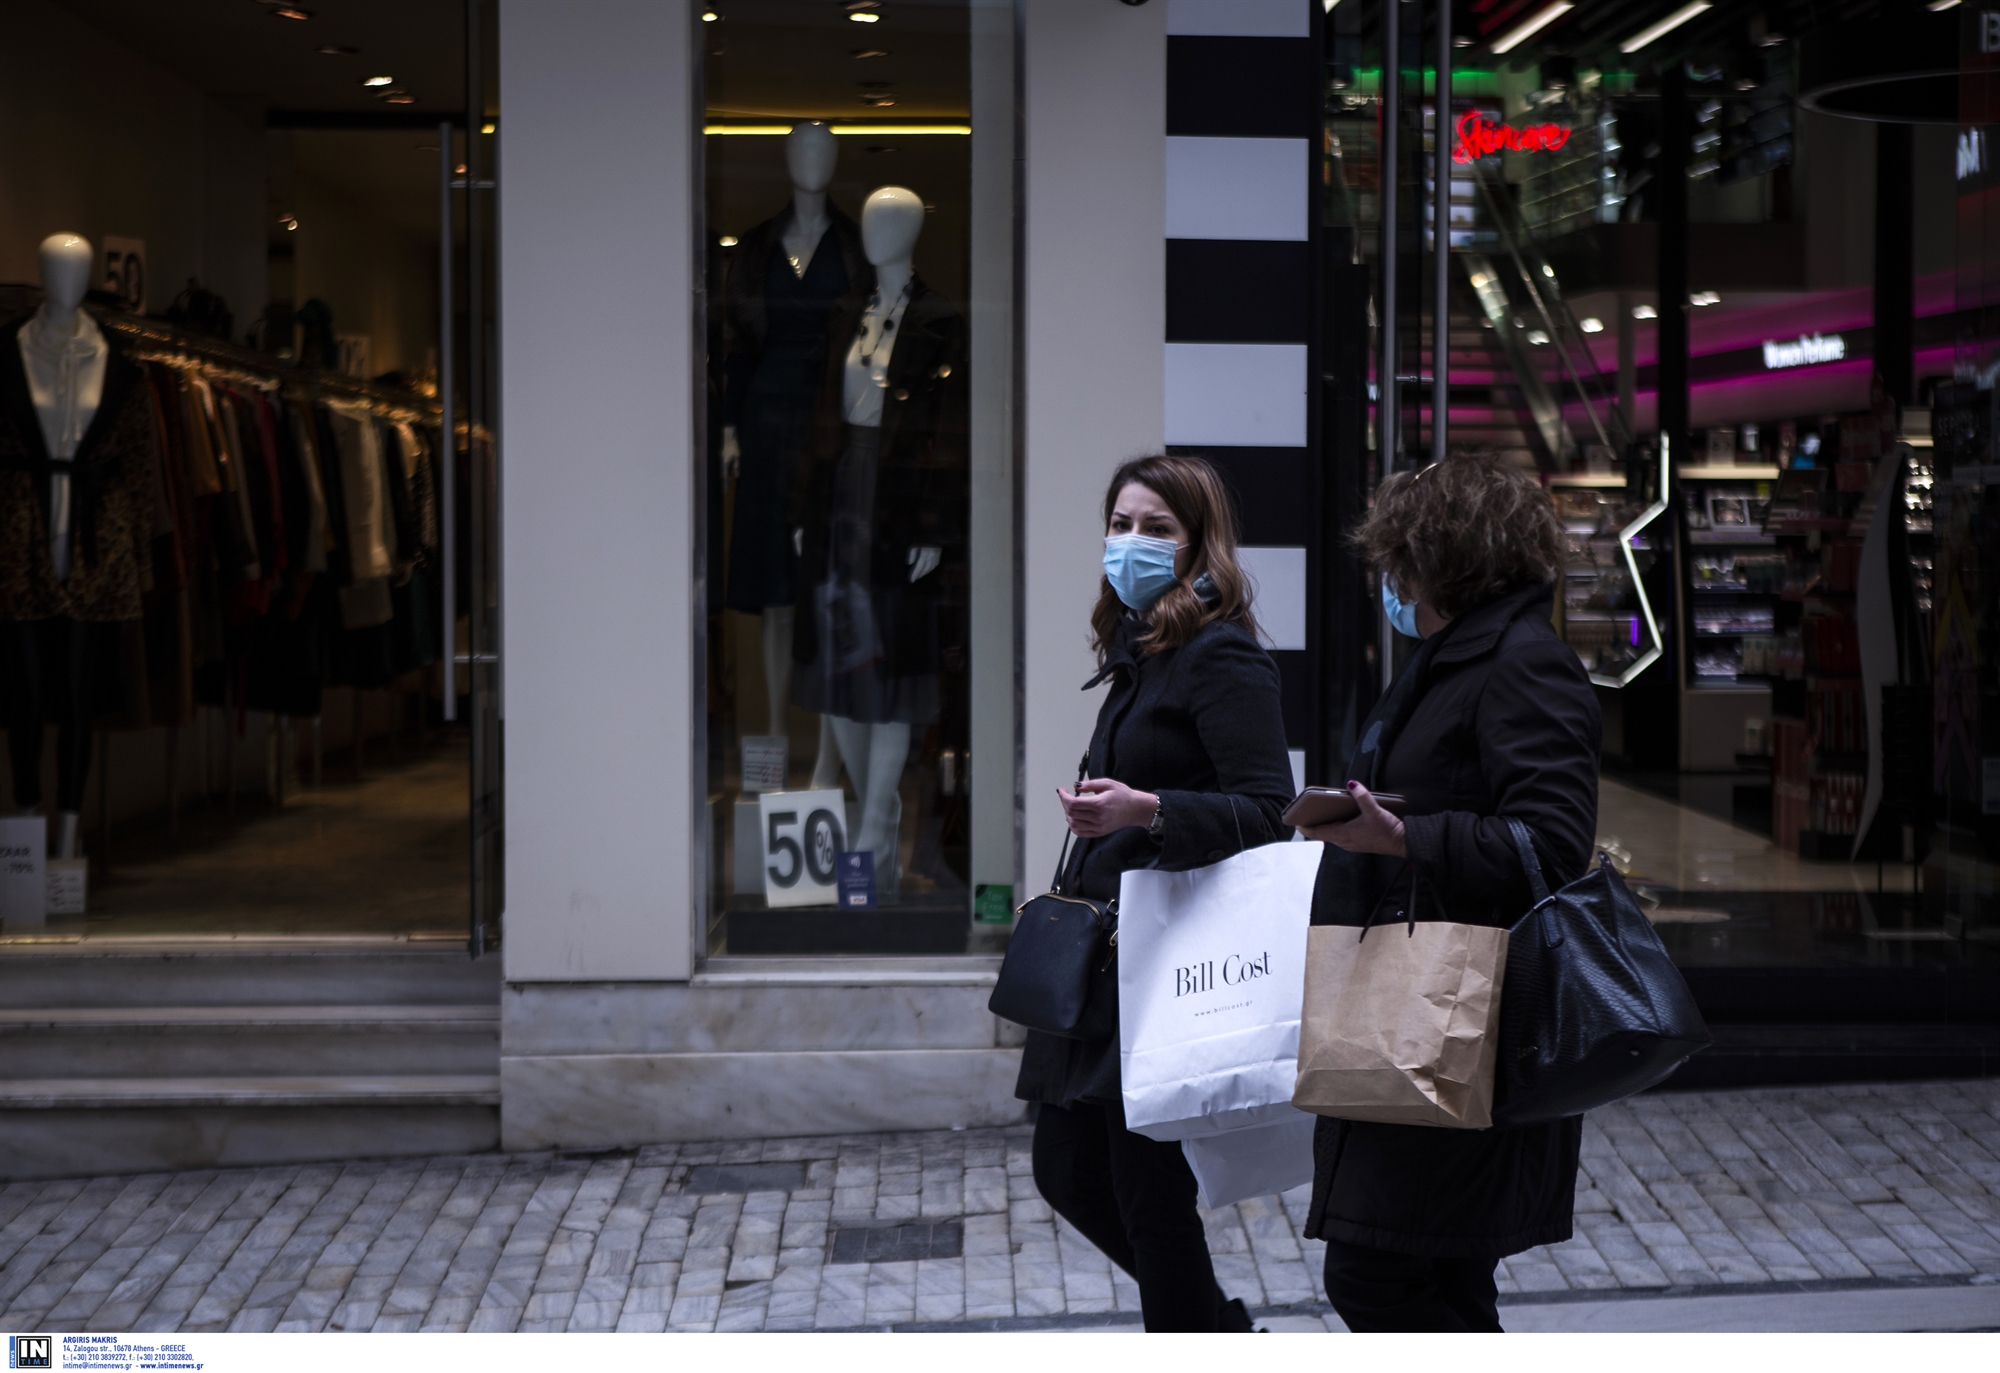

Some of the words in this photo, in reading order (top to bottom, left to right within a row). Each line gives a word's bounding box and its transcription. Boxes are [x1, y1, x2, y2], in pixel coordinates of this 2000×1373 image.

[987, 891, 1004, 902] Tax
[981, 902, 1006, 914] Free
[1174, 961, 1214, 998] Bill
[1223, 951, 1273, 986] Cost
[1194, 1000, 1253, 1017] www.billcost.gr
